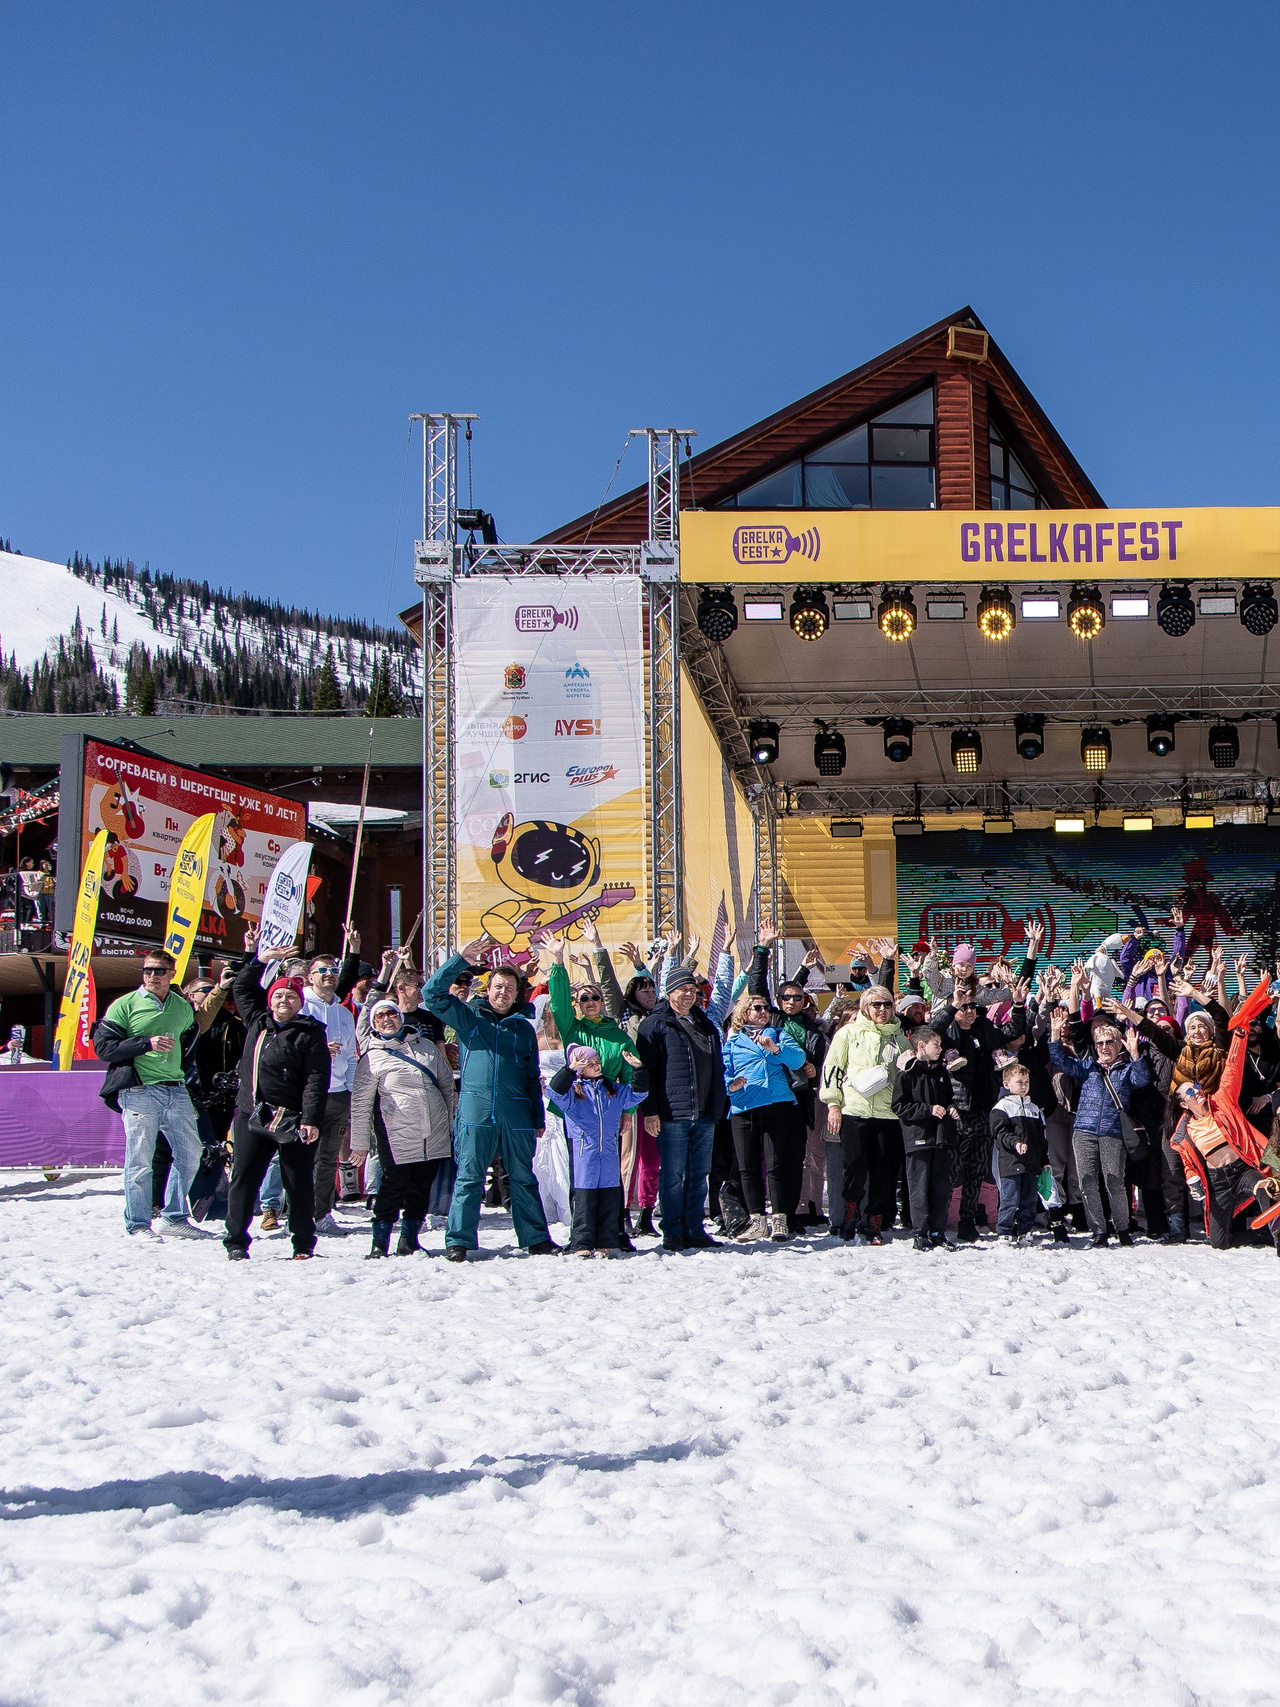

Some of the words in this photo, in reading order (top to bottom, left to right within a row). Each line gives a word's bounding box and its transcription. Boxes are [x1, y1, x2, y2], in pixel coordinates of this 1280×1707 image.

[742, 531, 783, 544] GRELKA
[961, 521, 1183, 563] GRELKAFEST
[742, 546, 770, 559] FEST
[521, 609, 552, 618] GRELKA
[521, 619, 542, 628] FEST
[555, 719, 601, 736] AYS!
[514, 773, 551, 783] 2ГИС
[97, 755, 167, 785] СОГРЕВАЕМ
[169, 775, 178, 787] В
[180, 778, 237, 805] ШЕРЕГЕШЕ
[239, 795, 261, 812] УЖЕ
[264, 803, 274, 815] 10
[276, 807, 298, 822] ЛЕТ!
[165, 817, 180, 832] Пн.
[267, 838, 282, 855] Ср.
[106, 912, 126, 923] 10:00
[126, 917, 136, 926] до
[136, 917, 153, 928] 0:00
[198, 913, 228, 937] LKA
[932, 911, 998, 931] GRELKA
